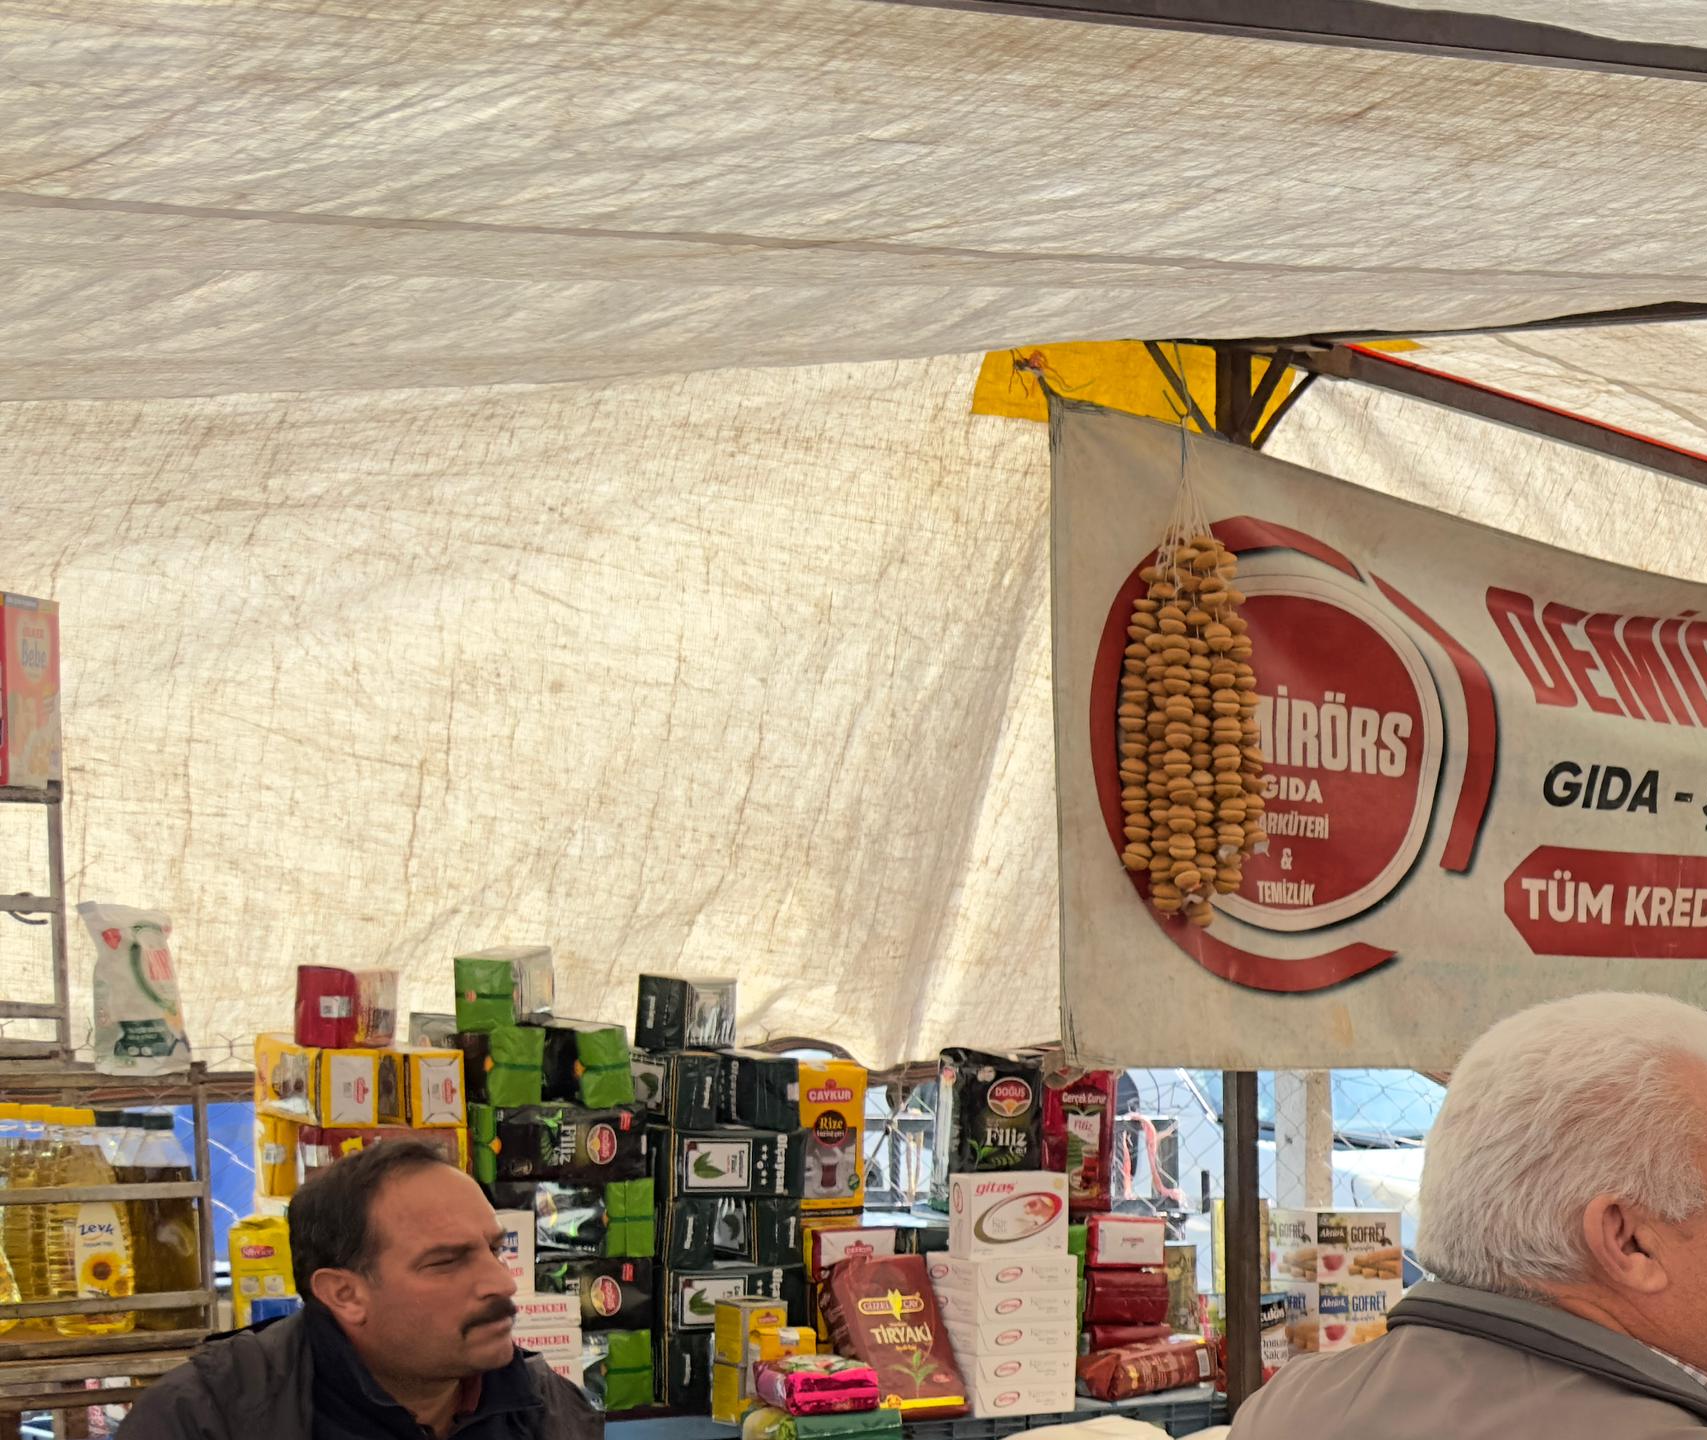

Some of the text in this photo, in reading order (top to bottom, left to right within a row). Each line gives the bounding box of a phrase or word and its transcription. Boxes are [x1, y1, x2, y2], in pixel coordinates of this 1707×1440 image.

[1260, 774, 1323, 804] GIDA
[1542, 761, 1660, 814] GIDA
[1259, 810, 1329, 839] ARKÜTERİ
[1281, 847, 1293, 870] &
[1257, 878, 1315, 905] TEMİZLİK
[1521, 870, 1615, 924] TÜM
[819, 1117, 844, 1130] Rize
[985, 1126, 1028, 1147] Filiz
[1351, 1225, 1386, 1244] GOFRET
[1352, 1295, 1387, 1313] GOFRET
